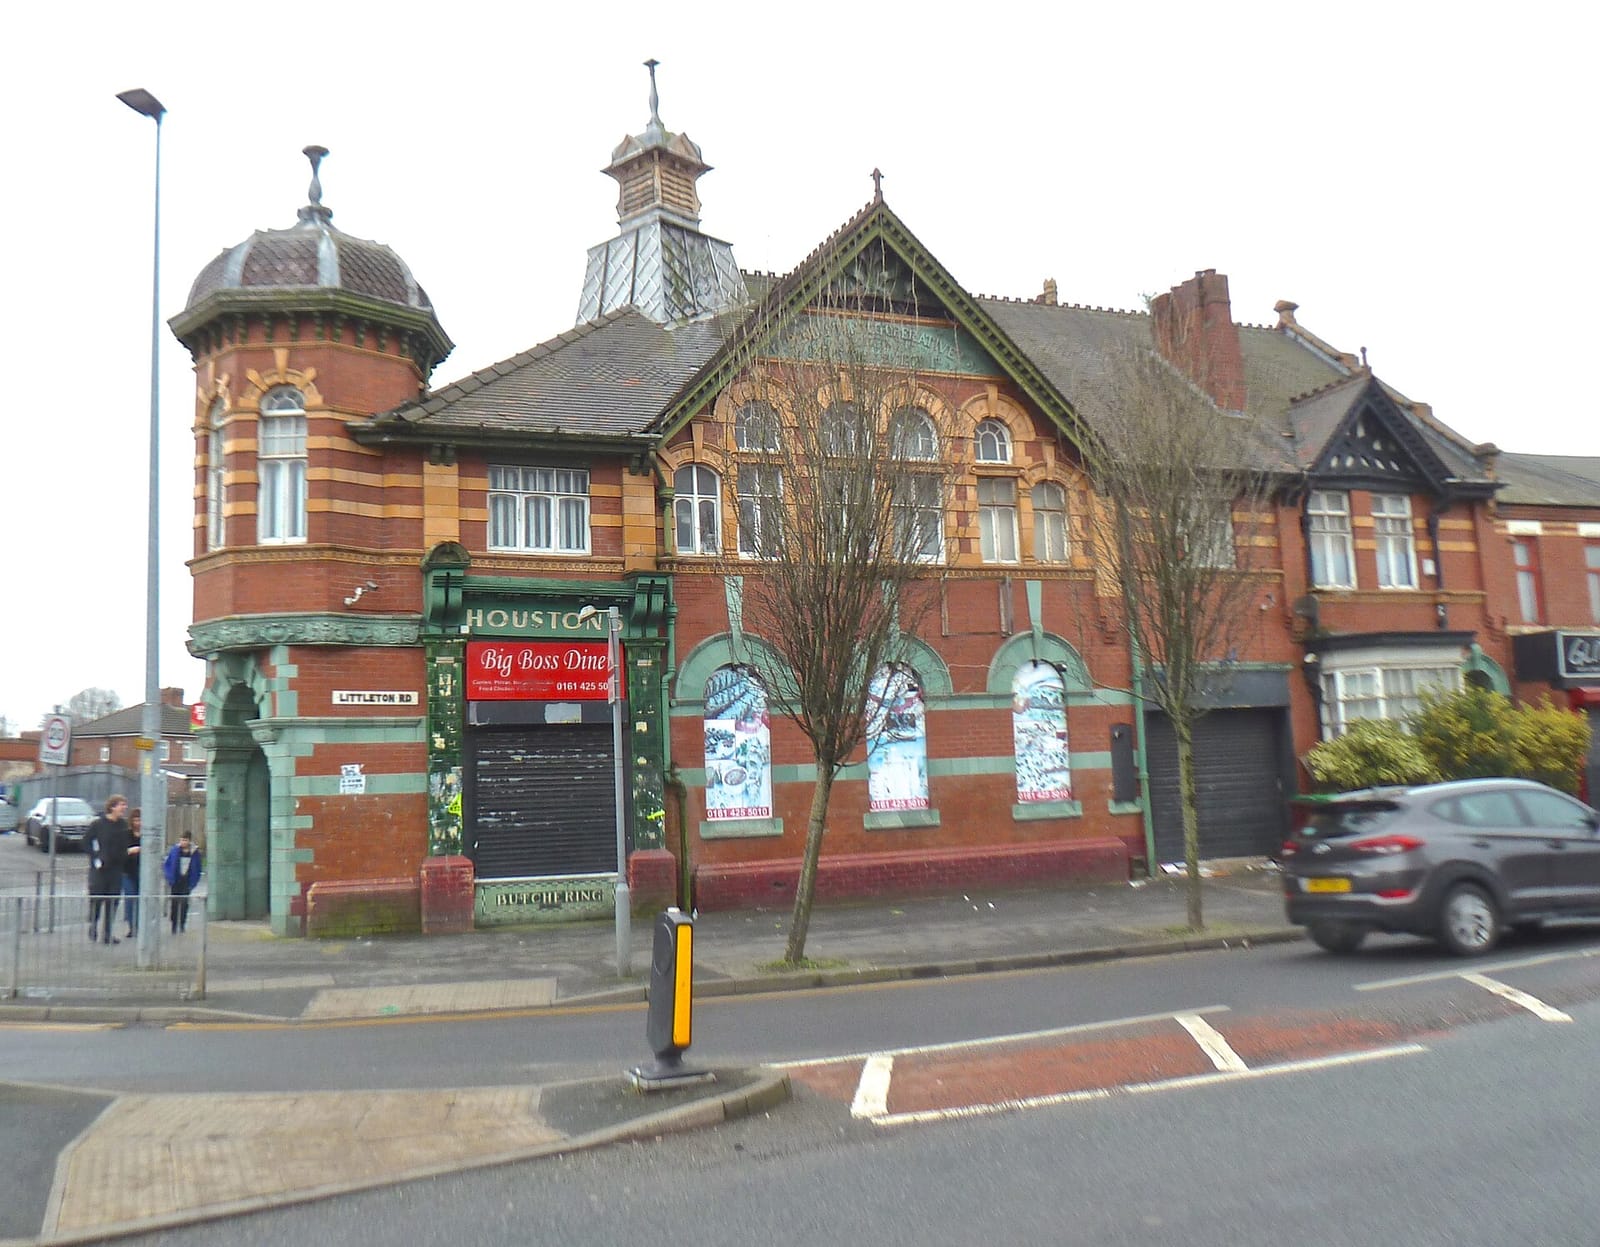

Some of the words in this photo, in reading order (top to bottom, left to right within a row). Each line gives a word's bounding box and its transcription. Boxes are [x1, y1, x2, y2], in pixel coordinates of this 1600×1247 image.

[481, 648, 513, 678] Big
[518, 649, 560, 670] Boss
[563, 649, 609, 670] Dine
[556, 682, 577, 691] 0161
[580, 682, 596, 691] 425
[340, 693, 395, 703] LITTLETON
[399, 694, 412, 703] RD
